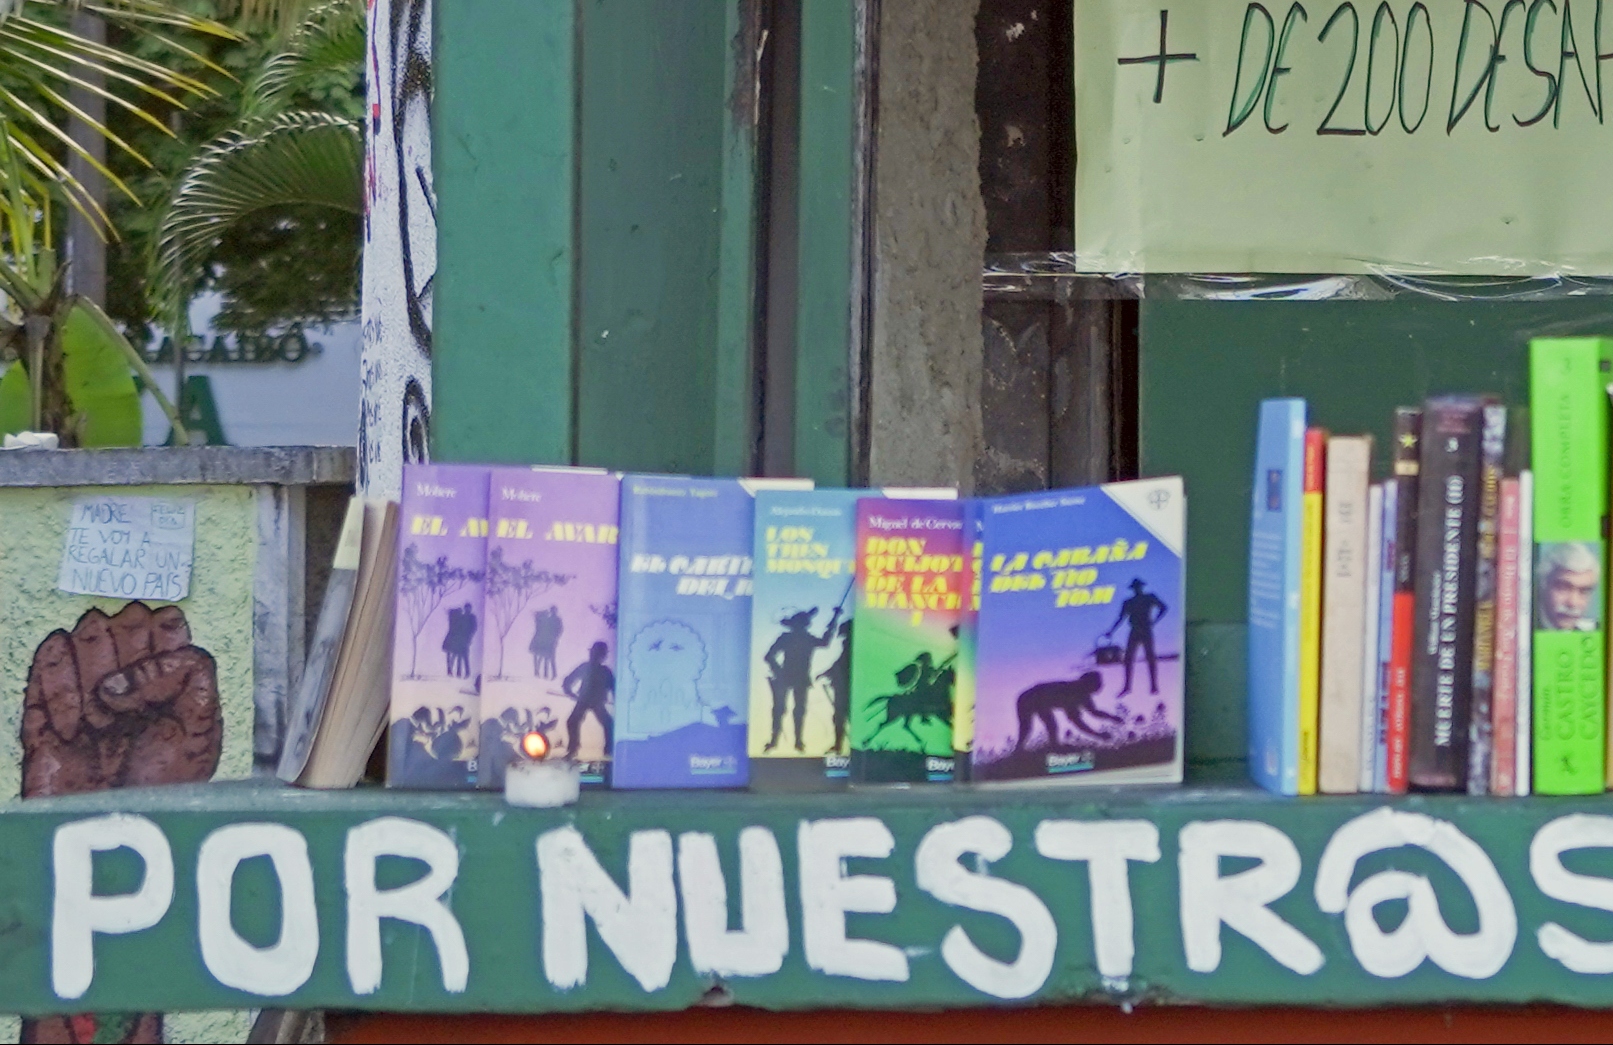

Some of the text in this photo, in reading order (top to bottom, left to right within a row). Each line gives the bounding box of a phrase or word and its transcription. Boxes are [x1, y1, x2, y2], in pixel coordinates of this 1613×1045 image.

[1222, 0, 1308, 138] DE
[1317, 0, 1434, 136] 200
[1559, 394, 1572, 480] COMPLETA
[80, 502, 132, 524] MADRE
[869, 516, 908, 531] Miguel
[70, 527, 89, 545] TE
[140, 531, 152, 547] A
[545, 521, 619, 544] AVAR
[68, 544, 180, 571] REGALAR UN
[866, 536, 927, 555] DON
[990, 537, 1149, 576] LA CABAÑA
[865, 554, 963, 576] QUIJOT
[1442, 506, 1462, 614] PRESIDENTE
[72, 568, 137, 595] NUEVO
[866, 575, 948, 593] DE LA
[989, 573, 1047, 593] DEL
[866, 592, 962, 610] MANCH
[1054, 585, 1116, 608] TOM
[1439, 616, 1457, 642] UN
[1437, 643, 1456, 670] DE
[1554, 651, 1576, 741] CASTRO
[1578, 636, 1600, 741] CAYCEDO
[1434, 671, 1455, 747] MUERTE
[825, 755, 849, 769] Bay
[926, 756, 954, 771] Bay
[50, 812, 470, 1000] POR
